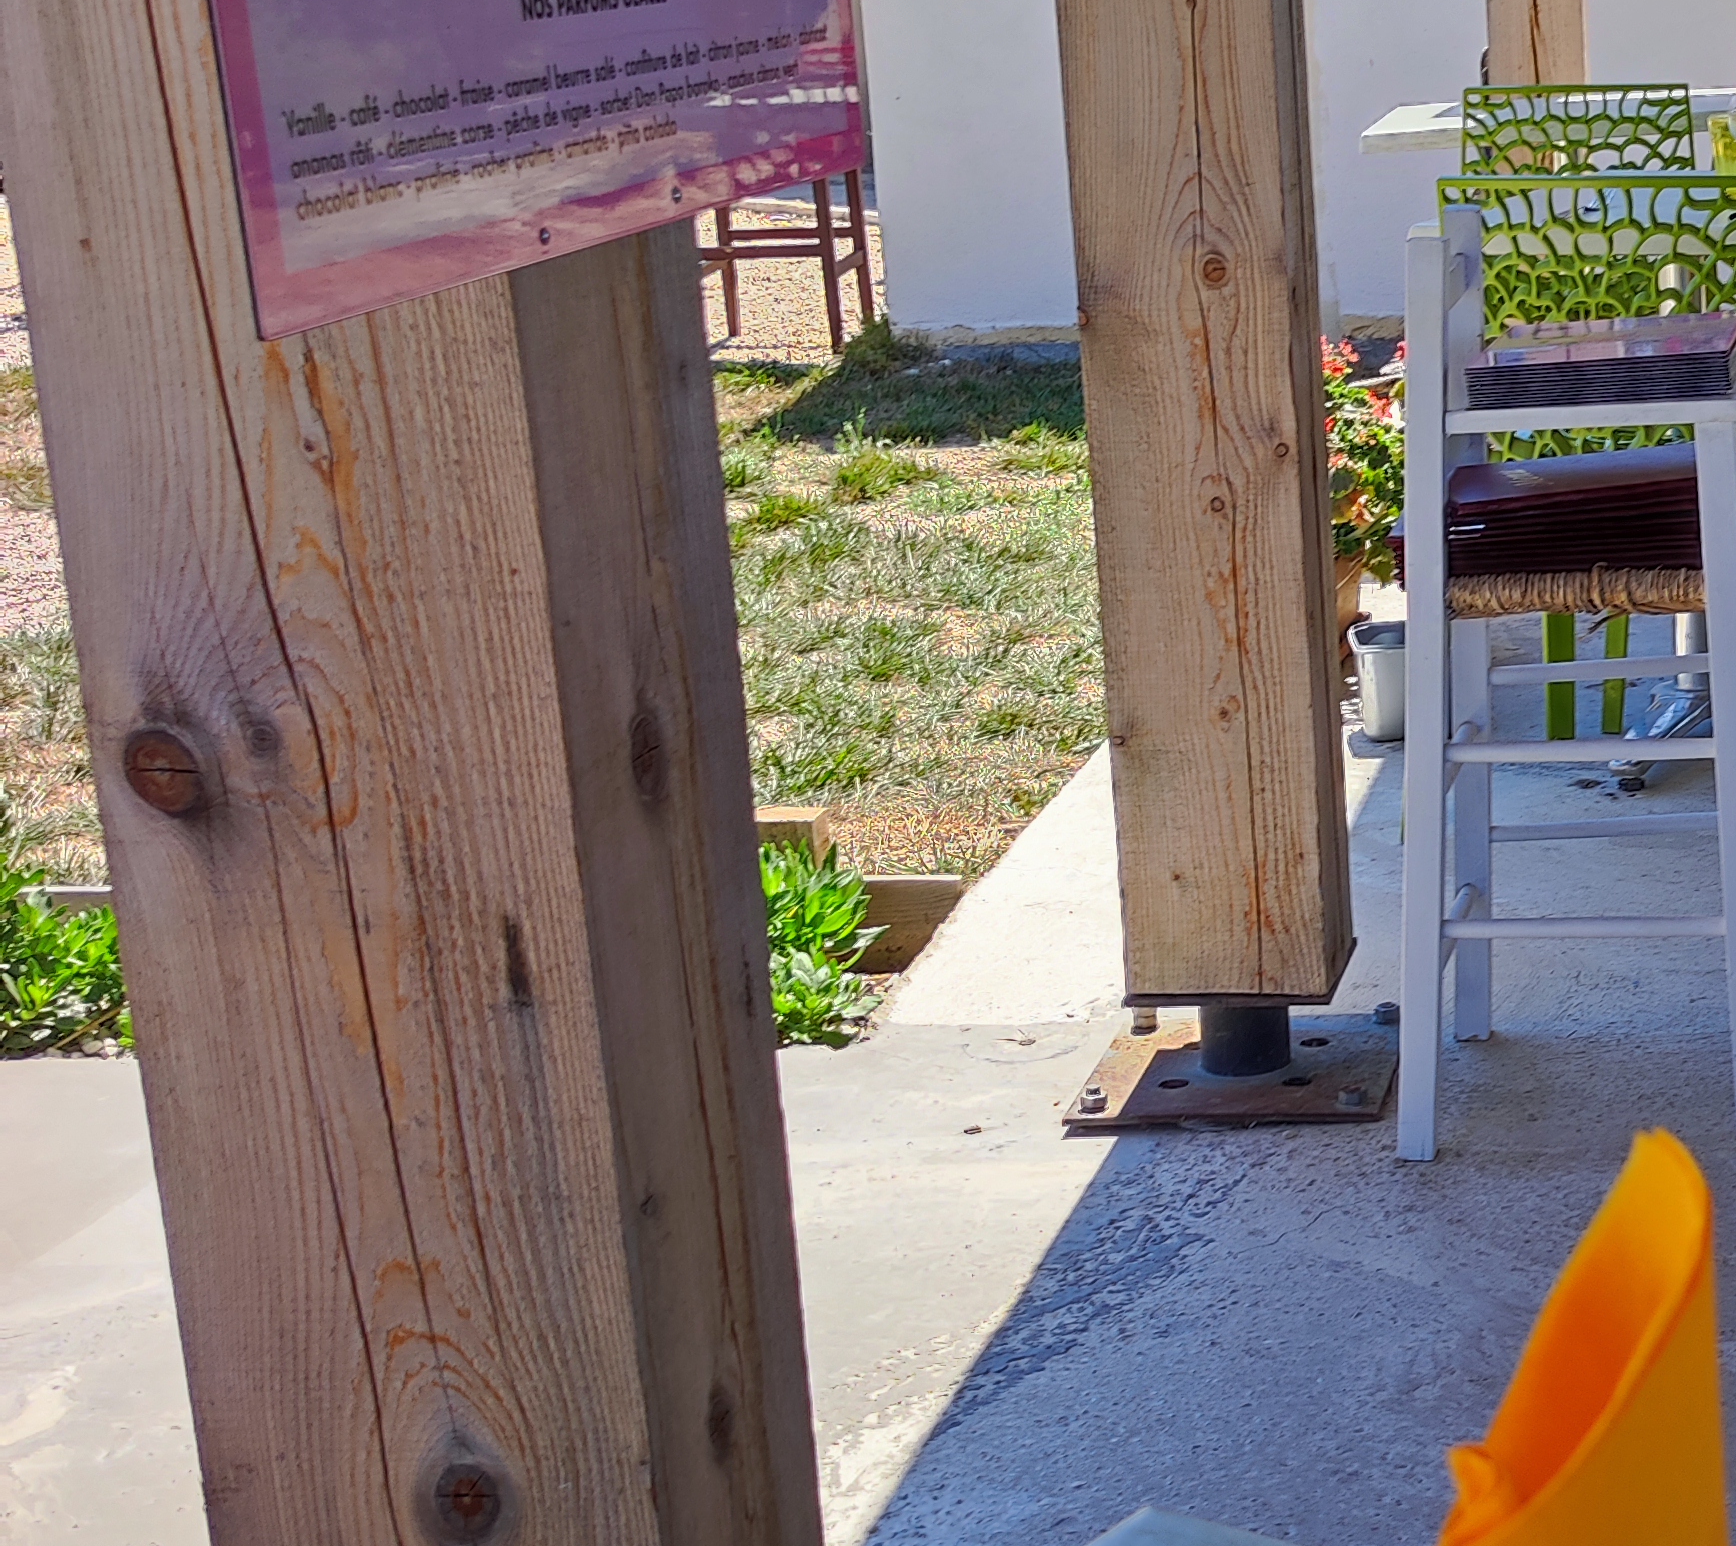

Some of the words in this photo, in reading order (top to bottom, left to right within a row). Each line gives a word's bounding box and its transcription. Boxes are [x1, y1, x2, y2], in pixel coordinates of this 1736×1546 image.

[281, 102, 338, 138] Vanille
[348, 94, 382, 127] café
[392, 84, 450, 119] chocolat
[458, 79, 495, 108] fraise
[504, 65, 553, 99] caramel
[552, 64, 592, 90] beurre
[594, 55, 617, 83] salé
[670, 44, 684, 70] de
[684, 42, 701, 66] lait
[289, 152, 347, 180] ananas
[385, 124, 459, 160] clémentine
[460, 122, 496, 145] corse
[503, 105, 541, 143] pêche
[543, 101, 560, 127] de
[561, 99, 593, 129] vigne
[634, 86, 657, 109] Don
[296, 180, 360, 222] chocolat
[361, 174, 405, 206] blanc
